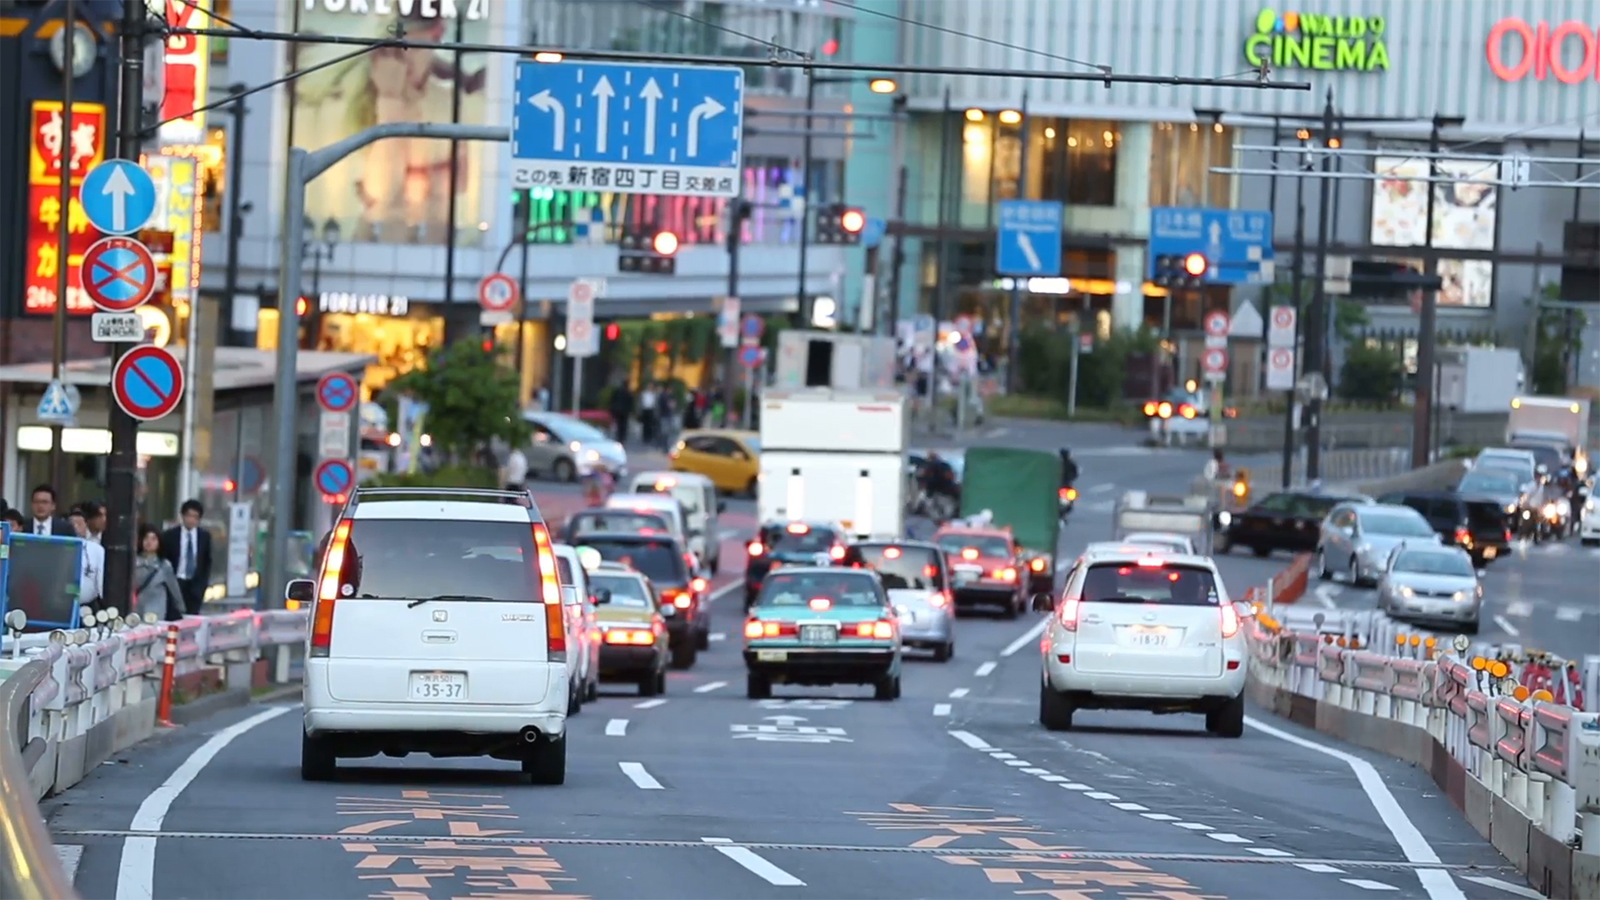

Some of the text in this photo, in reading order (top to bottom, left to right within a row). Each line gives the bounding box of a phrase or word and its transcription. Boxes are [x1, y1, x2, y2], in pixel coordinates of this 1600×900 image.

[1300, 13, 1367, 37] WALD
[1246, 32, 1391, 71] CINEMA
[423, 683, 462, 698] 35-37
